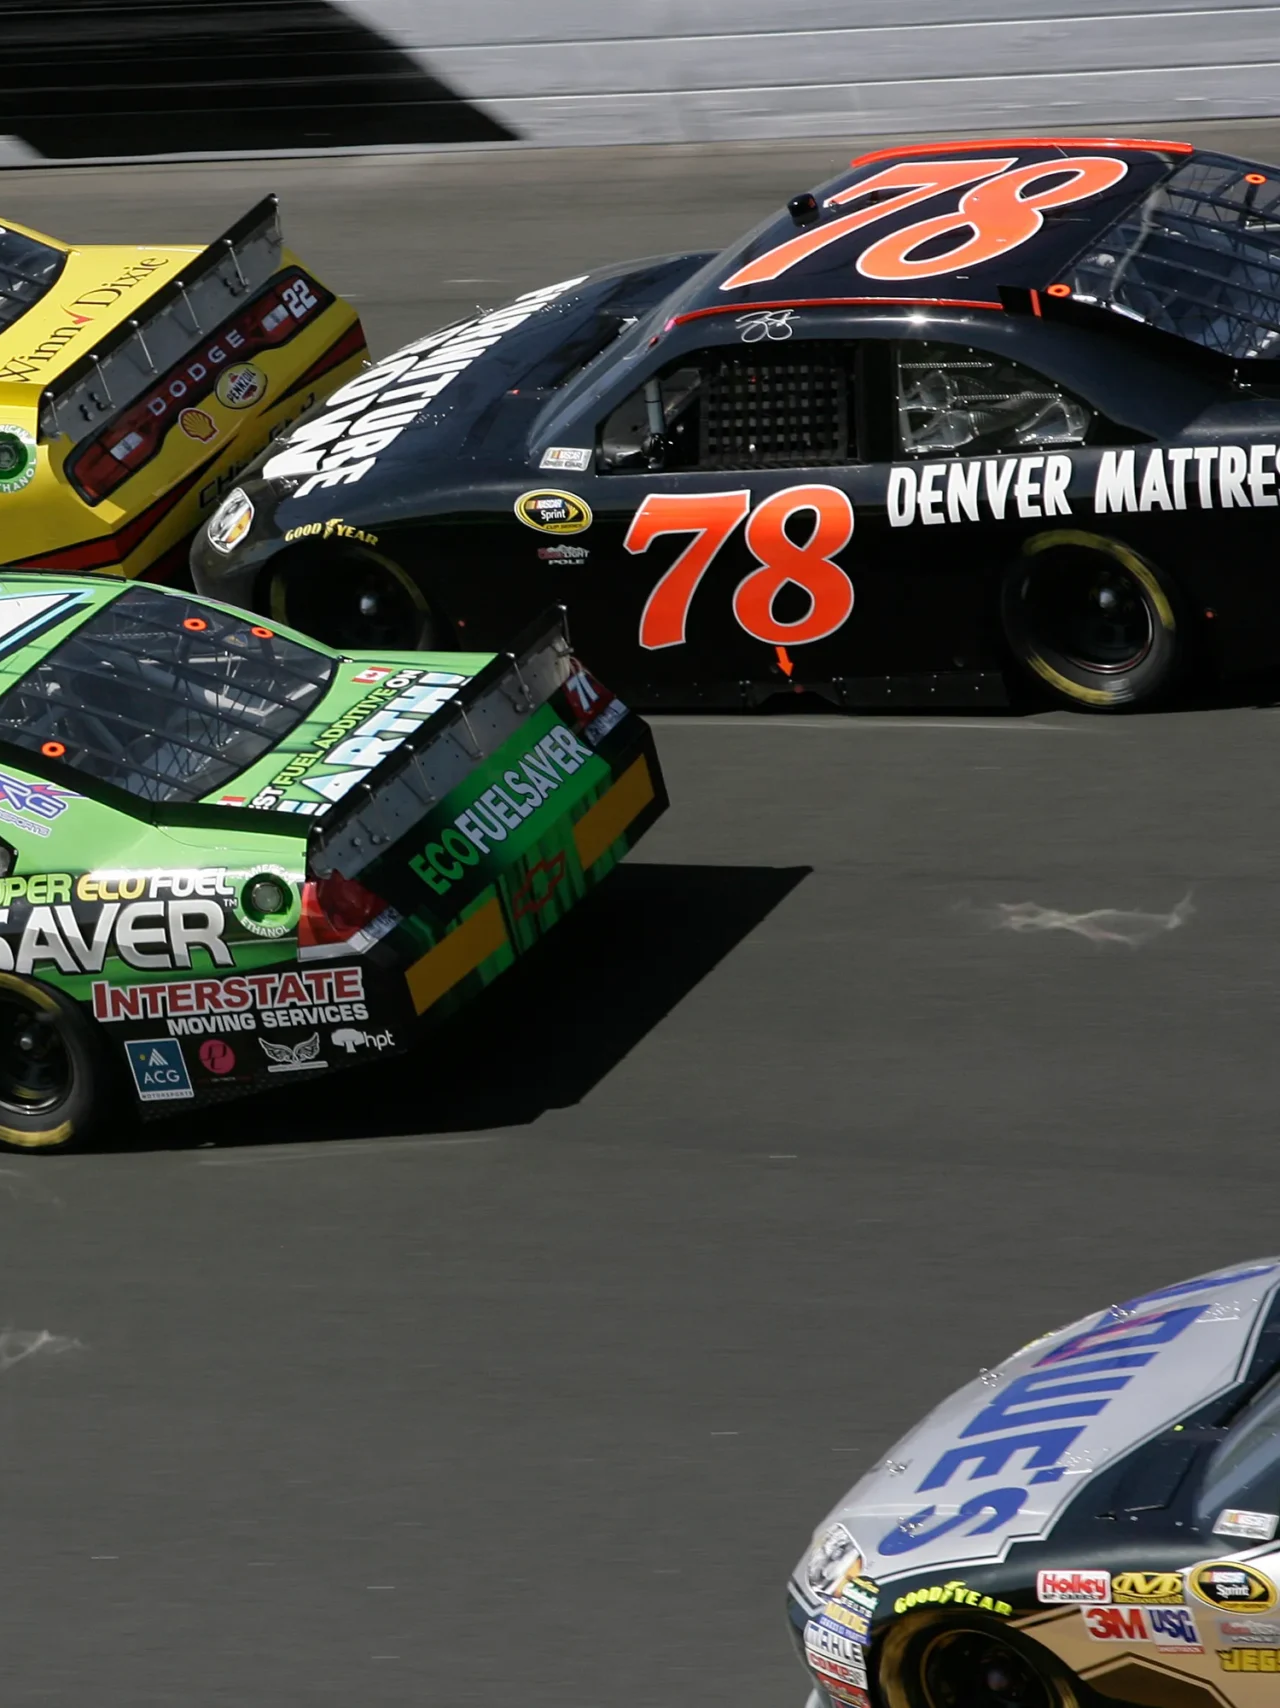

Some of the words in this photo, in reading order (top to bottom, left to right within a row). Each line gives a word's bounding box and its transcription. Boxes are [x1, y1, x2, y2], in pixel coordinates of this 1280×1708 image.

[720, 156, 1128, 290] 78
[73, 255, 170, 308] Dixie
[281, 278, 318, 319] 22
[148, 329, 245, 417] DODGE
[225, 368, 258, 405] PENNZOIL
[293, 275, 590, 498] FURNITURE
[887, 455, 1073, 528] DENVER
[1095, 444, 1280, 515] MATTRE
[284, 518, 380, 547] GOODYEAR
[540, 509, 566, 521] Sprint
[623, 483, 855, 651] 78
[566, 671, 599, 713] 71
[273, 751, 325, 786] FUEL
[315, 688, 400, 750] ADDITIVE
[385, 669, 426, 689] ON
[77, 874, 147, 901] ECO
[150, 867, 235, 898] FUEL
[240, 916, 291, 939] ETHANOL
[92, 966, 364, 1022] INTERSTATE
[167, 1011, 256, 1037] MOVING
[263, 1002, 370, 1029] SERVICES
[364, 1029, 396, 1051] hpt
[143, 1069, 180, 1085] ACG
[141, 1090, 193, 1100] MOTORSPORTS
[894, 1580, 1013, 1616] GOODYEAR
[1043, 1573, 1107, 1600] Holley
[1216, 1584, 1250, 1599] Sprint
[1087, 1608, 1150, 1639] 3M
[1148, 1609, 1199, 1643] USG
[1223, 1648, 1280, 1672] JEG
